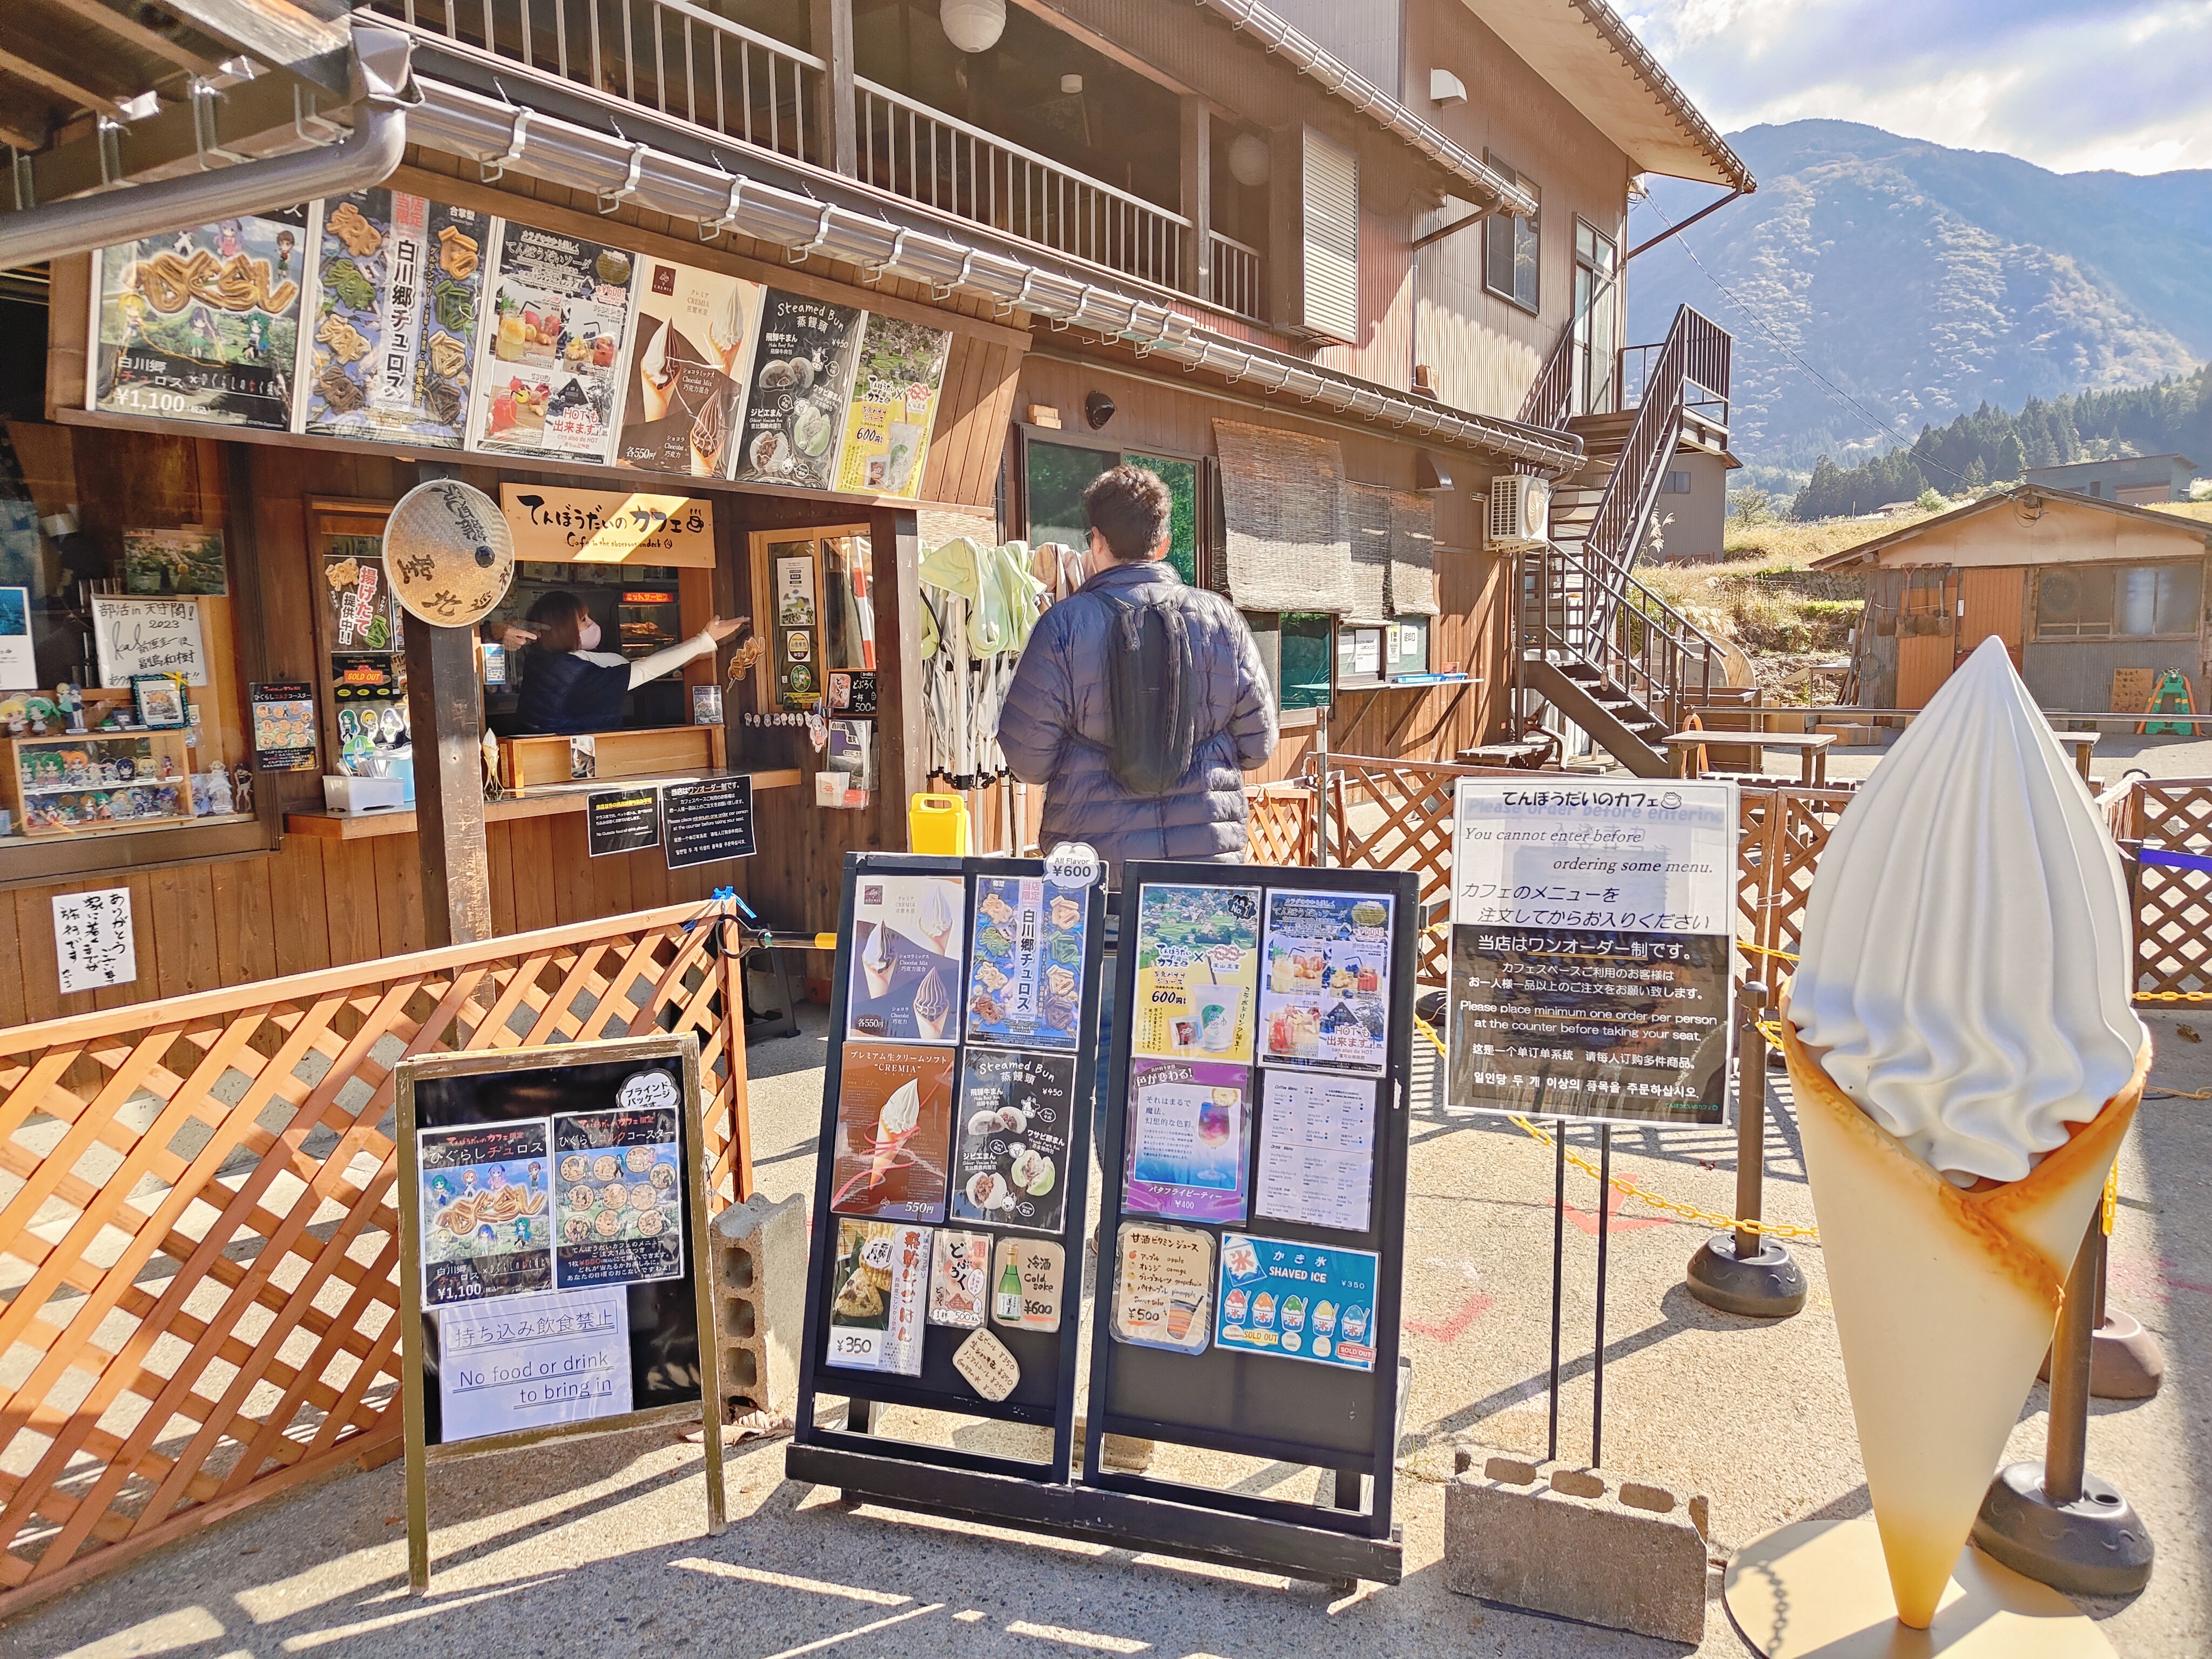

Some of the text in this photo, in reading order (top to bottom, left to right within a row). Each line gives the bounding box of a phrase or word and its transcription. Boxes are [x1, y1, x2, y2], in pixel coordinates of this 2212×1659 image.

[654, 284, 672, 293] CREMIA
[687, 297, 710, 308] CREMIA
[380, 239, 419, 398] 白川郷チュロス
[777, 301, 845, 333] Steamed Bun
[796, 315, 829, 334] 蒸饅頭
[765, 332, 798, 343] 飛騨牛まん
[831, 338, 849, 349] ¥450
[117, 355, 167, 373] 白川郷
[682, 367, 716, 379] ショコラミックス
[682, 375, 713, 387] Chocolat Mix
[116, 387, 185, 413] ¥1,100
[563, 406, 585, 420] HOT
[750, 408, 783, 417] ジビエまん
[666, 434, 686, 442] ショコラ
[626, 446, 657, 461] 各550円
[664, 442, 684, 451] Chocolat
[664, 450, 682, 459] 巧克力
[516, 494, 683, 533] てんぼうだいのカフェ
[567, 531, 590, 550] Cafe
[356, 565, 378, 636] 揚げたて
[626, 593, 670, 601] ホットサービス
[149, 620, 180, 629] 2023
[347, 673, 381, 681] SOLD OUT
[852, 679, 874, 690] どぶろく
[855, 703, 876, 712] 500円
[1502, 790, 1659, 808] てんぼうだいのカフェ
[1465, 826, 1642, 844] You cannot enter before
[1065, 857, 1090, 865] Flavor
[1553, 858, 1713, 874] ordering some menu.
[1053, 865, 1091, 878] ¥600
[1022, 881, 1040, 892] 当店
[1460, 882, 1620, 903] カフェのメニューを
[1021, 891, 1040, 901] 限定
[1231, 905, 1243, 915] No.
[109, 893, 129, 955] ありがとう
[1476, 906, 1710, 930] 注文してからお入りください
[1156, 945, 1192, 956] てんぼうだい
[1478, 934, 1691, 960] 当店はワンオーダー制です。
[1016, 909, 1037, 1011] 白川郷チュロス
[1157, 959, 1178, 968] カフェ
[1501, 962, 1675, 981] カフェスペースご利用のお客様は
[1468, 976, 1703, 1001] お一人様一品以上のご注文をお願い致します。
[1460, 1000, 1717, 1027] Please place minimum one order per person
[858, 1017, 885, 1029] 各550円
[1335, 1026, 1371, 1037] HOT も
[1474, 1019, 1701, 1042] at the counter before taking your seat.
[850, 1050, 947, 1065] プレミアム生クリームソフト
[1472, 1043, 1695, 1070] 这是一个单订单系统 请每人订购多件商品。
[979, 1061, 1055, 1083] Steamed Bun
[1000, 1070, 1036, 1085] 蒸饅頭
[625, 1081, 669, 1098] ブラインド
[970, 1087, 1003, 1096] 飛騨牛まん
[1042, 1087, 1063, 1097] ¥450
[1474, 1071, 1700, 1100] 일인당 두 개 이상의 품목을 주문하십시오.
[628, 1090, 671, 1107] パッケージ
[1146, 1096, 1191, 1107] それはまるで
[1145, 1107, 1165, 1116] 魔法、
[1145, 1117, 1195, 1129] 幻想的な色彩。
[558, 1128, 675, 1147] ひぐらしコルクコースター
[1027, 1128, 1065, 1147] ワサビ豚まん
[430, 1142, 544, 1164] ひぐらしチュロス
[963, 1152, 997, 1161] ジビエまん
[905, 1201, 934, 1215] 550円
[1175, 1200, 1195, 1210] ¥400
[1130, 1232, 1200, 1252] 甘酒ビタミンジュース
[1027, 1255, 1051, 1271] 冷酒
[1140, 1253, 1160, 1262] アップル
[436, 1264, 467, 1276] 白川郷
[949, 1242, 973, 1291] どぶろく
[1138, 1262, 1162, 1272] オレンジ
[1024, 1273, 1047, 1283] Cold
[1269, 1266, 1327, 1284] SHAVED ICE
[437, 1283, 482, 1300] ¥1,100
[1033, 1282, 1054, 1293] sake
[1341, 1279, 1366, 1290] ¥350
[1171, 1288, 1197, 1297] pineapple
[1023, 1298, 1053, 1315] ¥600
[1128, 1307, 1160, 1321] ¥500
[455, 1309, 614, 1347] 持ち込み飲食禁止
[1244, 1331, 1278, 1342] SOLD OUT
[837, 1336, 872, 1354] ¥350
[1340, 1346, 1372, 1358] SOLD OUT
[460, 1351, 609, 1387] No food or drink
[520, 1377, 611, 1403] to bring in
